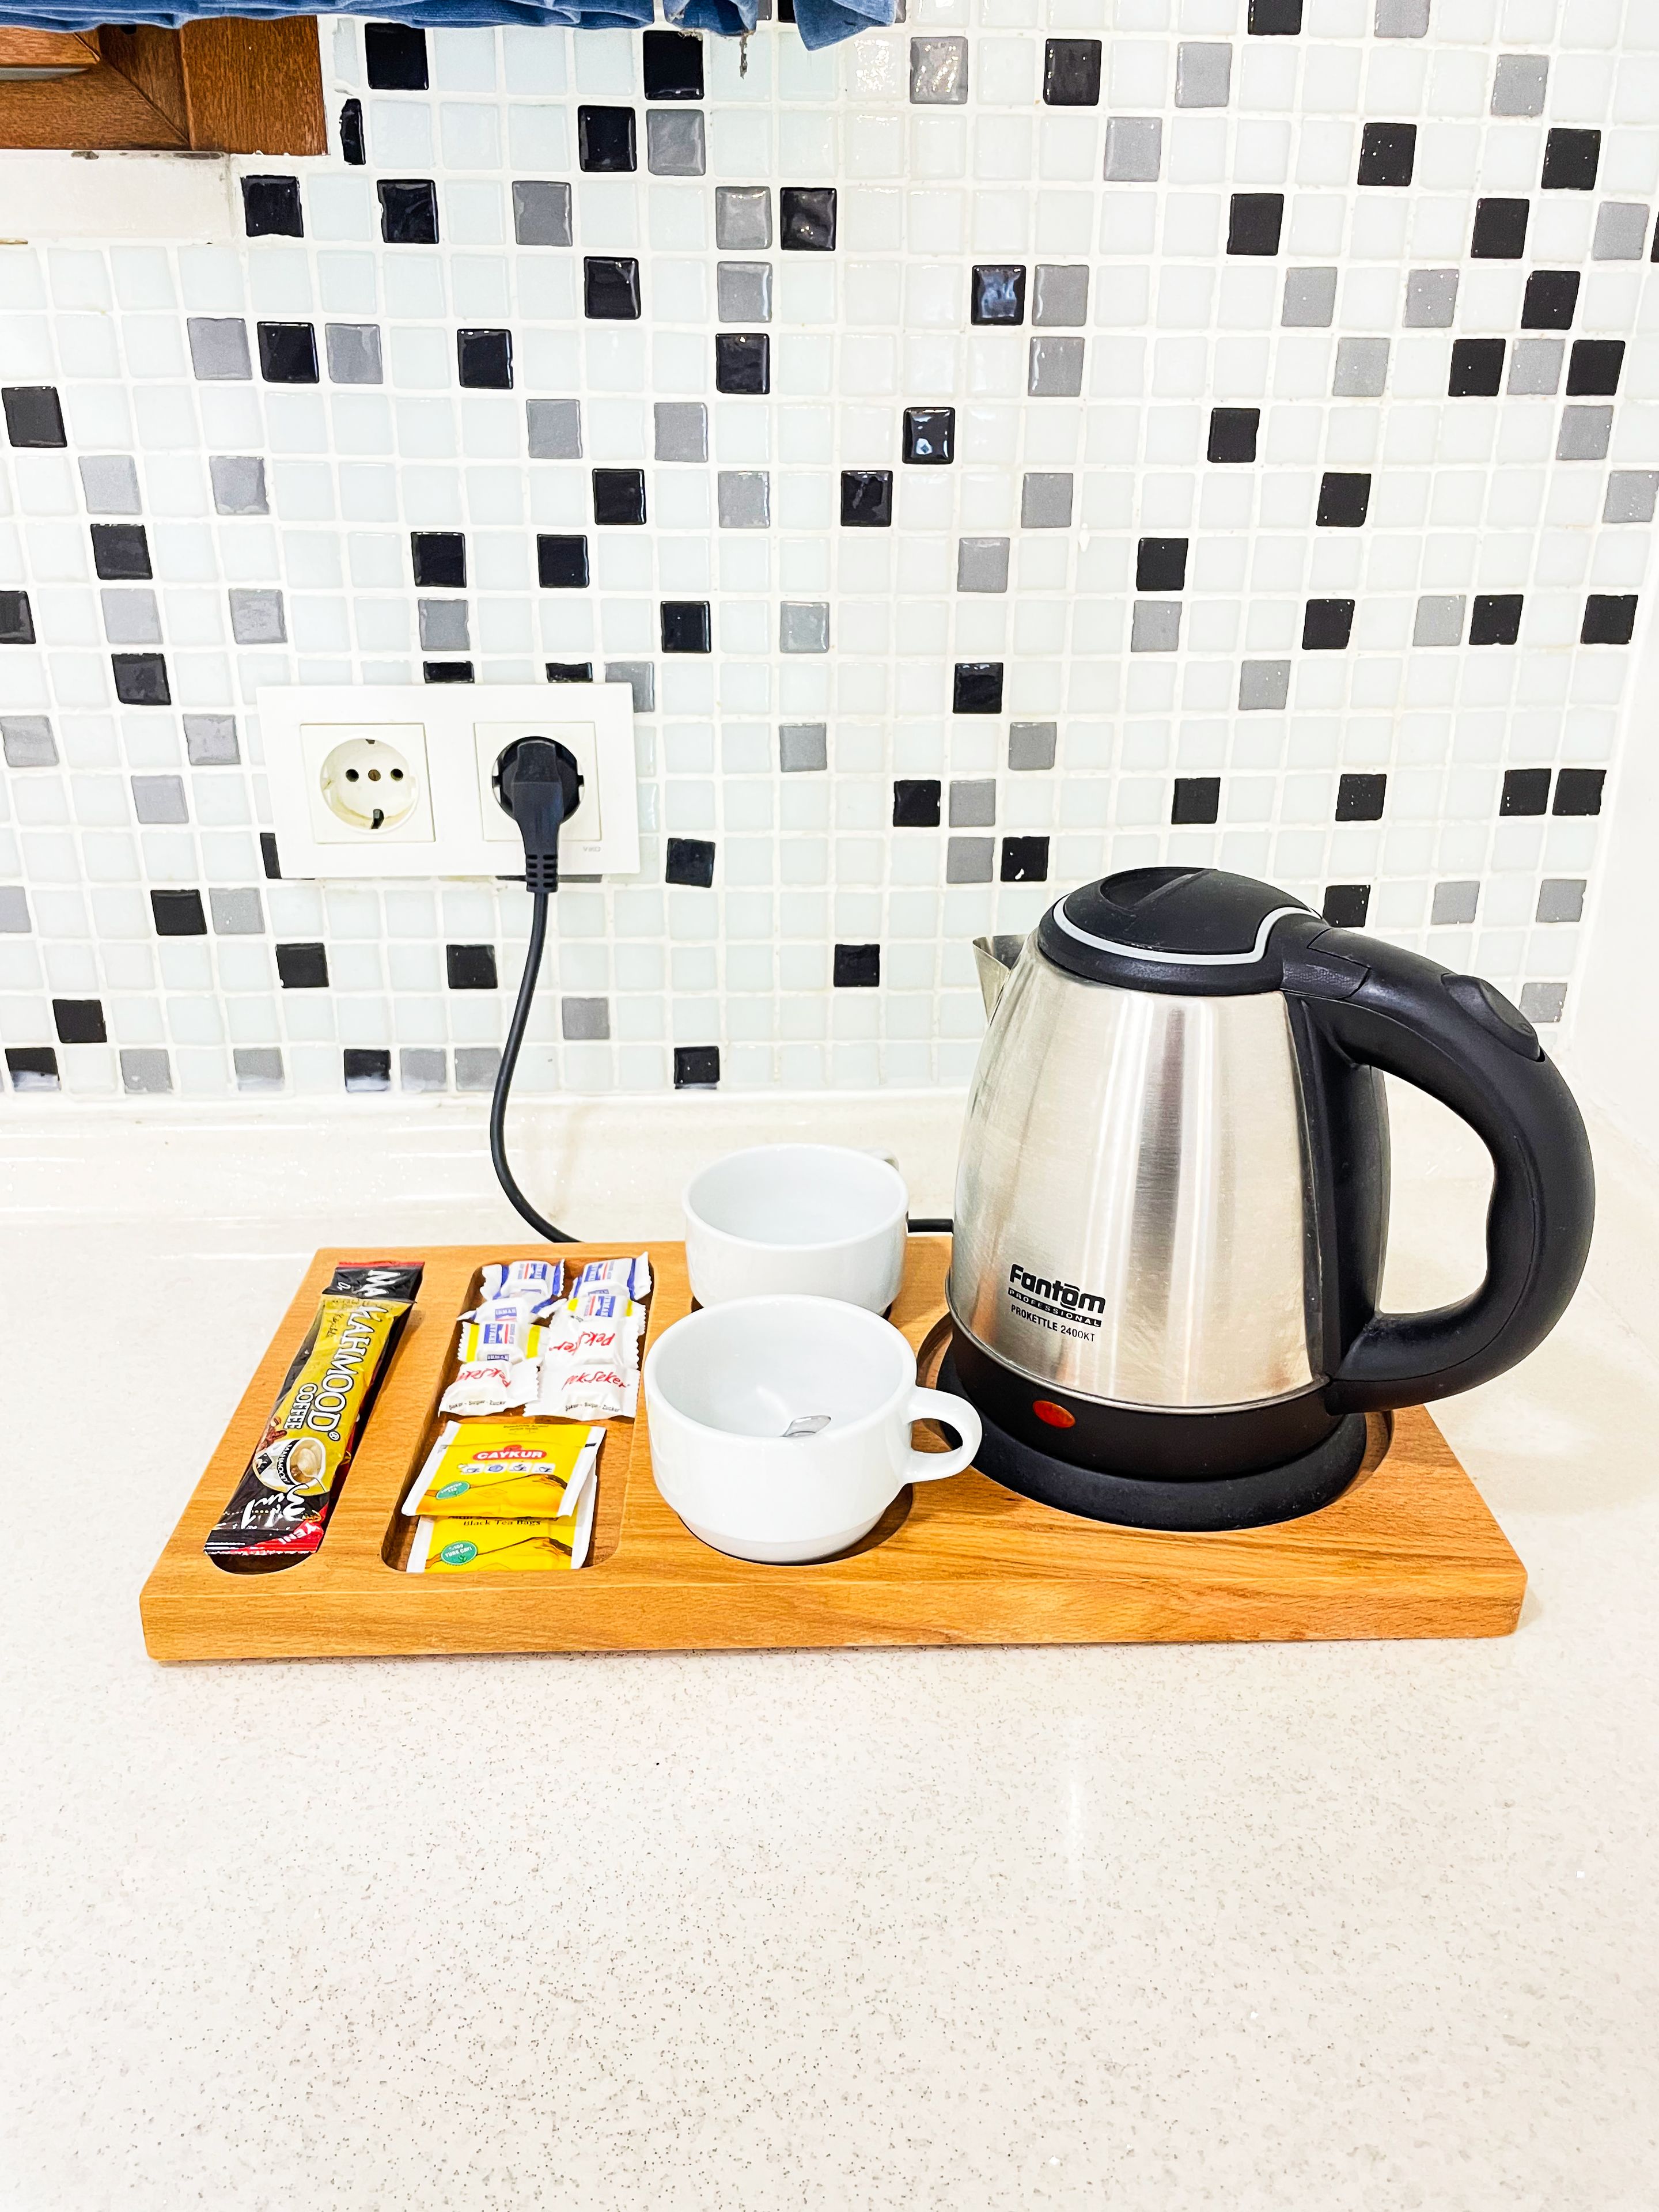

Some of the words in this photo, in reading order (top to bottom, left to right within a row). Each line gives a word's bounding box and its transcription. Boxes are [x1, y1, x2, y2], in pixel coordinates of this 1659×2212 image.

[1008, 1288, 1101, 1327] PROFESSIONAL
[1011, 1304, 1058, 1331] PROKETTLE
[1060, 1325, 1096, 1342] 2400KT
[283, 1383, 317, 1429] COFFEE
